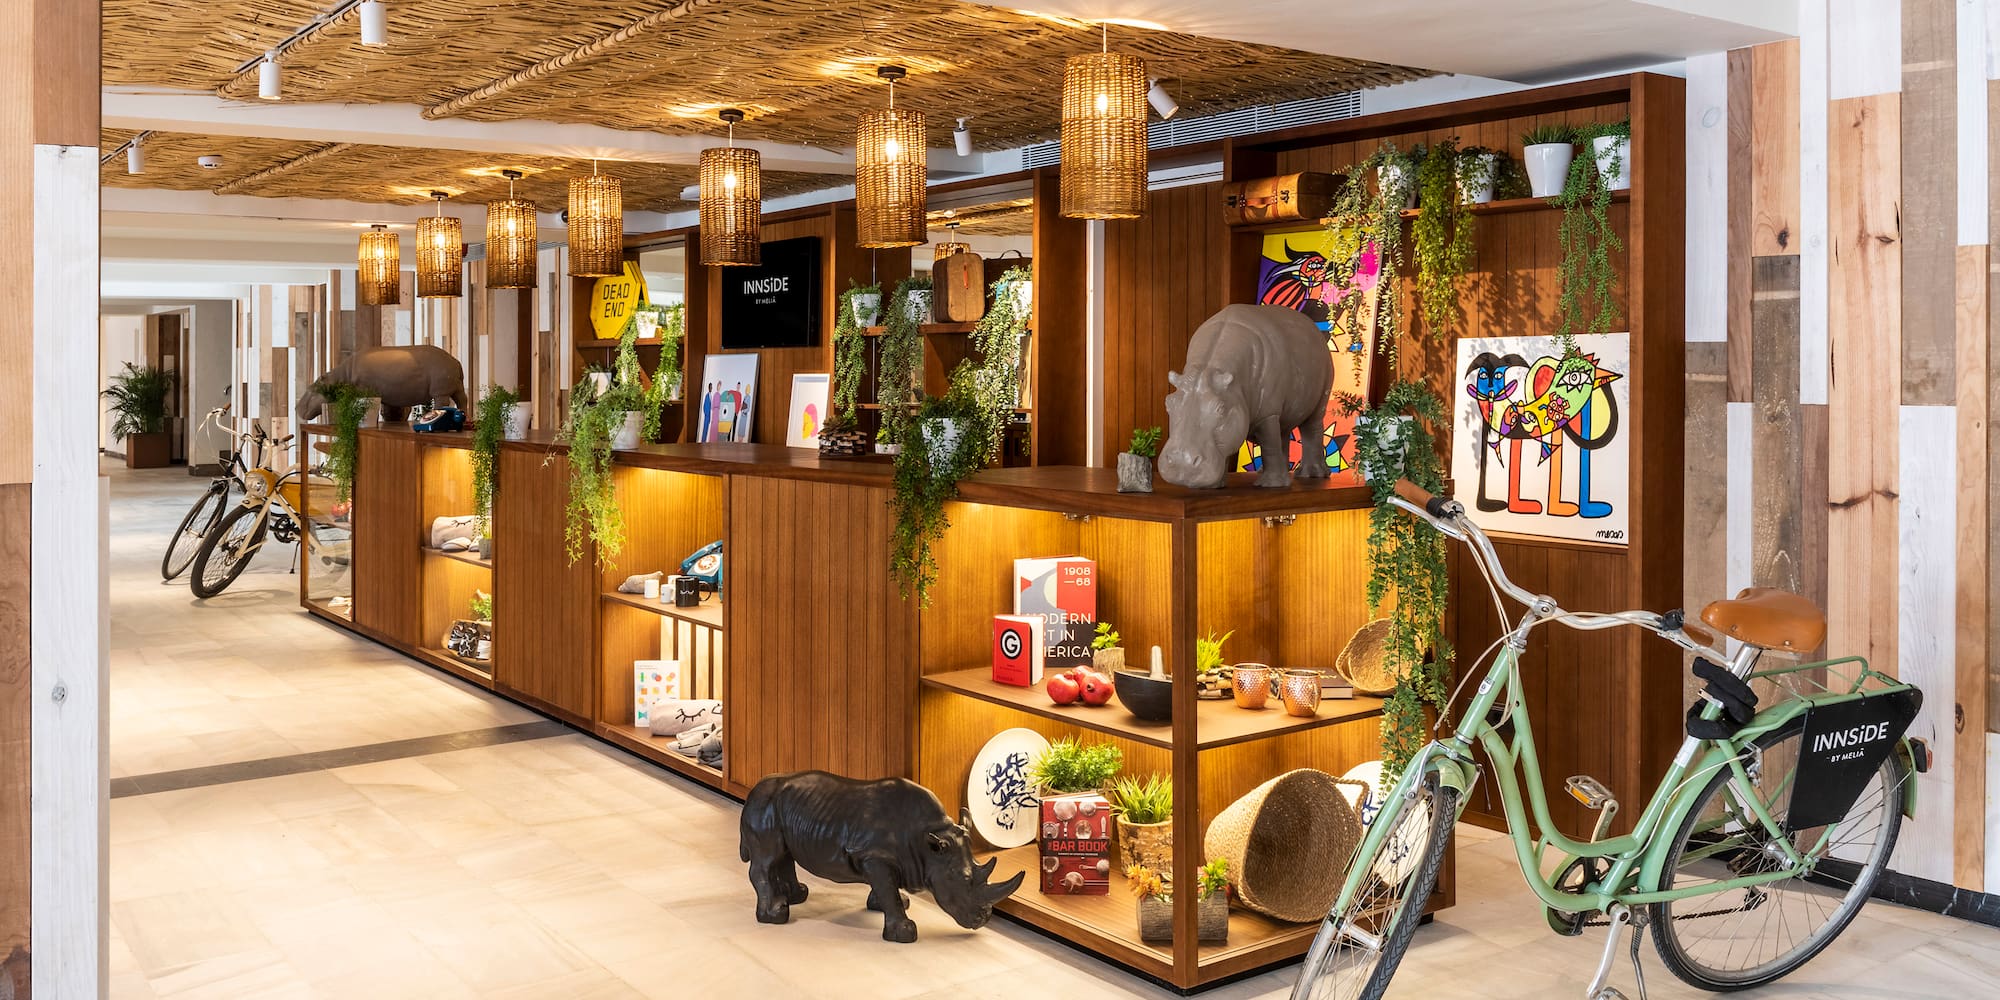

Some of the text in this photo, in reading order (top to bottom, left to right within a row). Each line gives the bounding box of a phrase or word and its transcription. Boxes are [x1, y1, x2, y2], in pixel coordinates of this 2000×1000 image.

[603, 283, 630, 300] DEAD
[604, 301, 624, 318] END
[1064, 567, 1091, 576] 1908
[1060, 629, 1075, 640] IN
[1043, 646, 1091, 657] ERICA
[1053, 841, 1075, 851] BAR
[1078, 841, 1107, 851] BOOK
